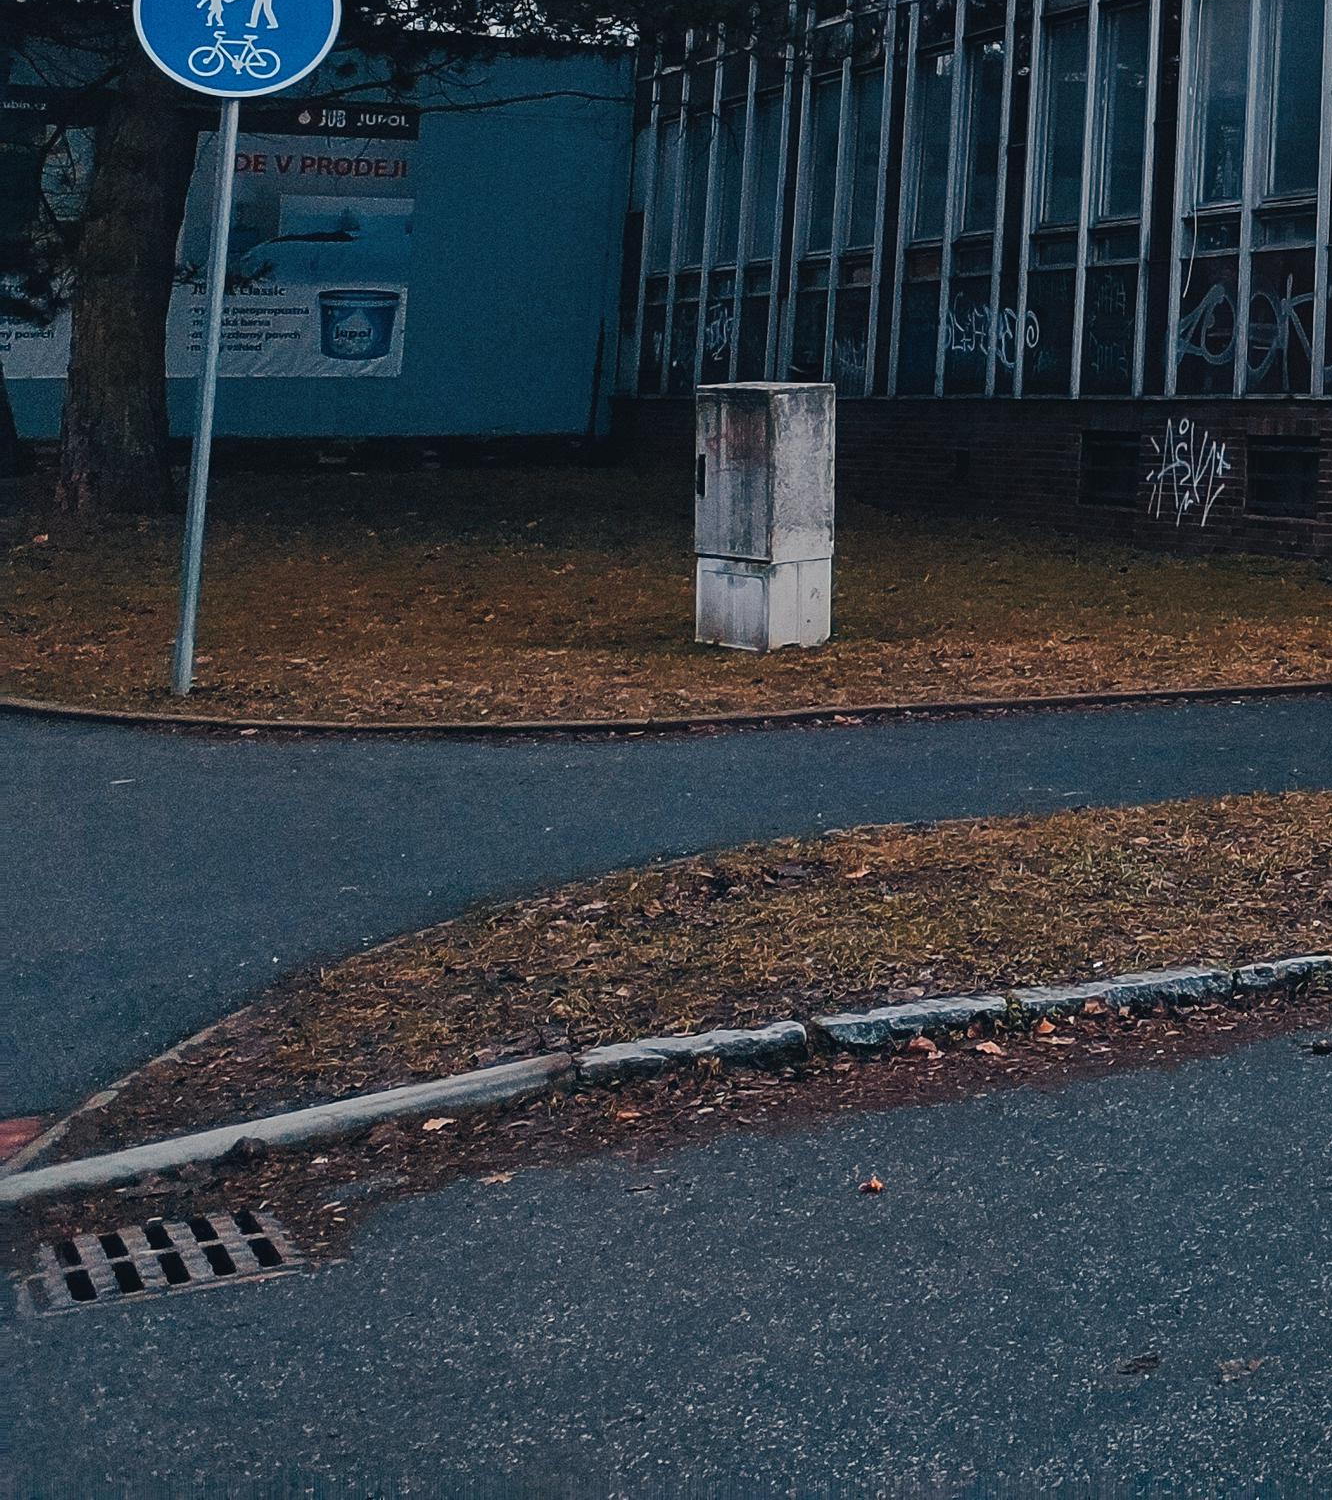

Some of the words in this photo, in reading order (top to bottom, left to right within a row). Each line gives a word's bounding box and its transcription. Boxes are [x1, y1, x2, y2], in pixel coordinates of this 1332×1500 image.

[318, 108, 347, 128] JUB
[275, 155, 293, 174] V
[300, 155, 408, 179] PRODEJI
